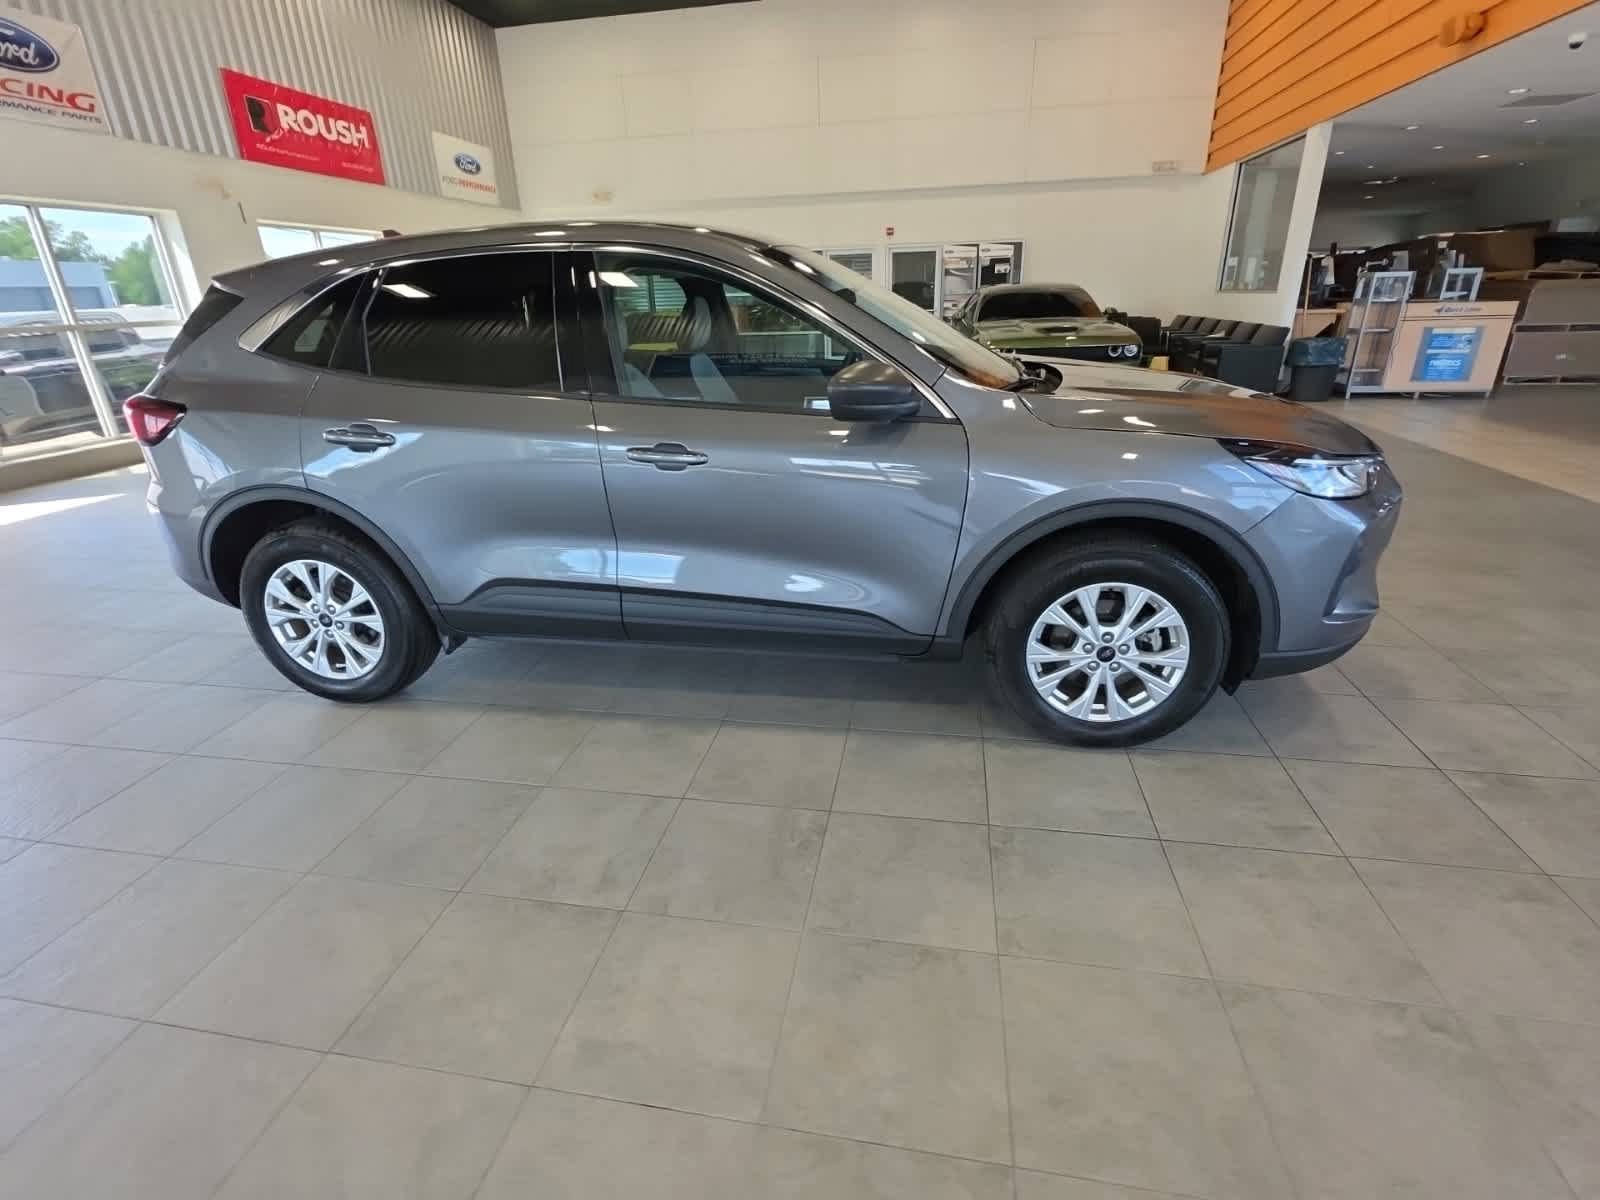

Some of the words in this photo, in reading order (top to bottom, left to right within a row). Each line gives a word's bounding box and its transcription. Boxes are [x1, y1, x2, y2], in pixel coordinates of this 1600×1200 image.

[0, 27, 40, 65] rd
[0, 100, 56, 116] MANCE
[276, 103, 371, 149] ROUSH
